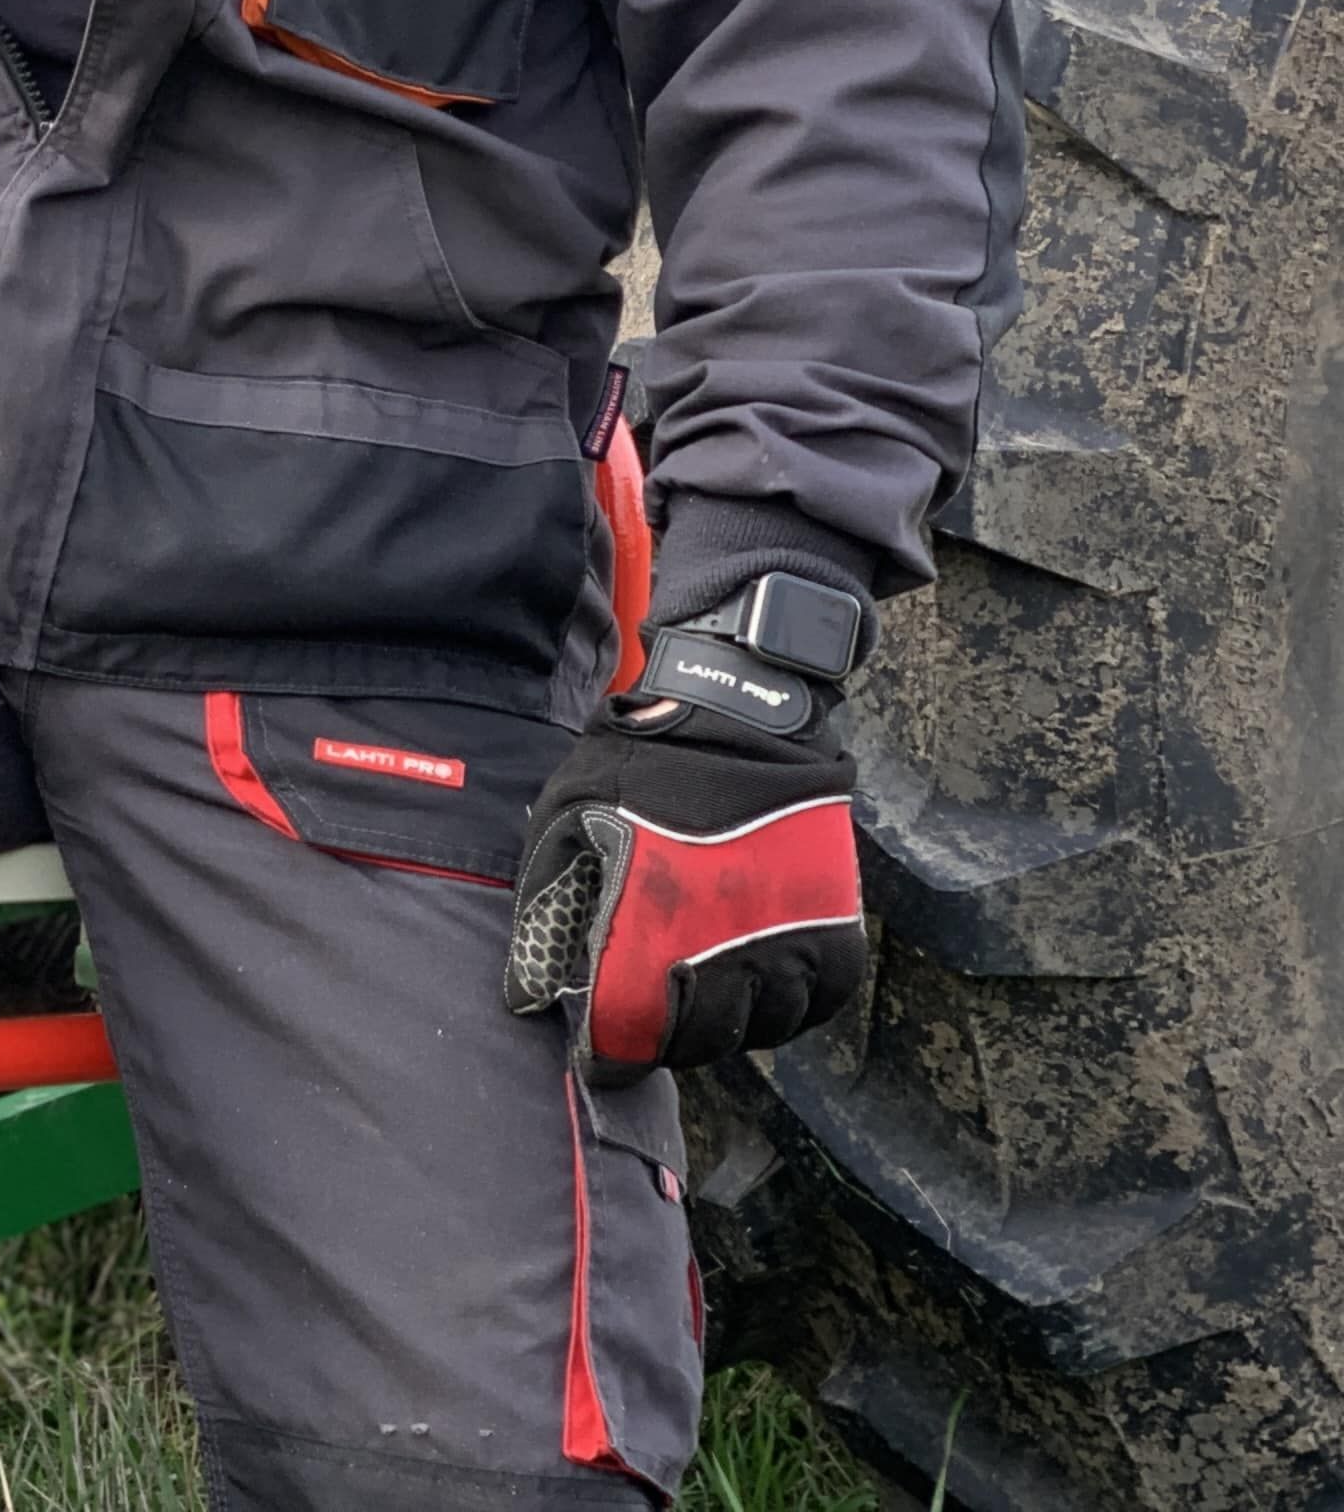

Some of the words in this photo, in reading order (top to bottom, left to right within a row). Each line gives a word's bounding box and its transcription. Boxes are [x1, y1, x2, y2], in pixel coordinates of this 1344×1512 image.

[677, 660, 737, 688] LAHTI
[326, 743, 395, 767] LAHTI
[403, 757, 453, 779] PRO
